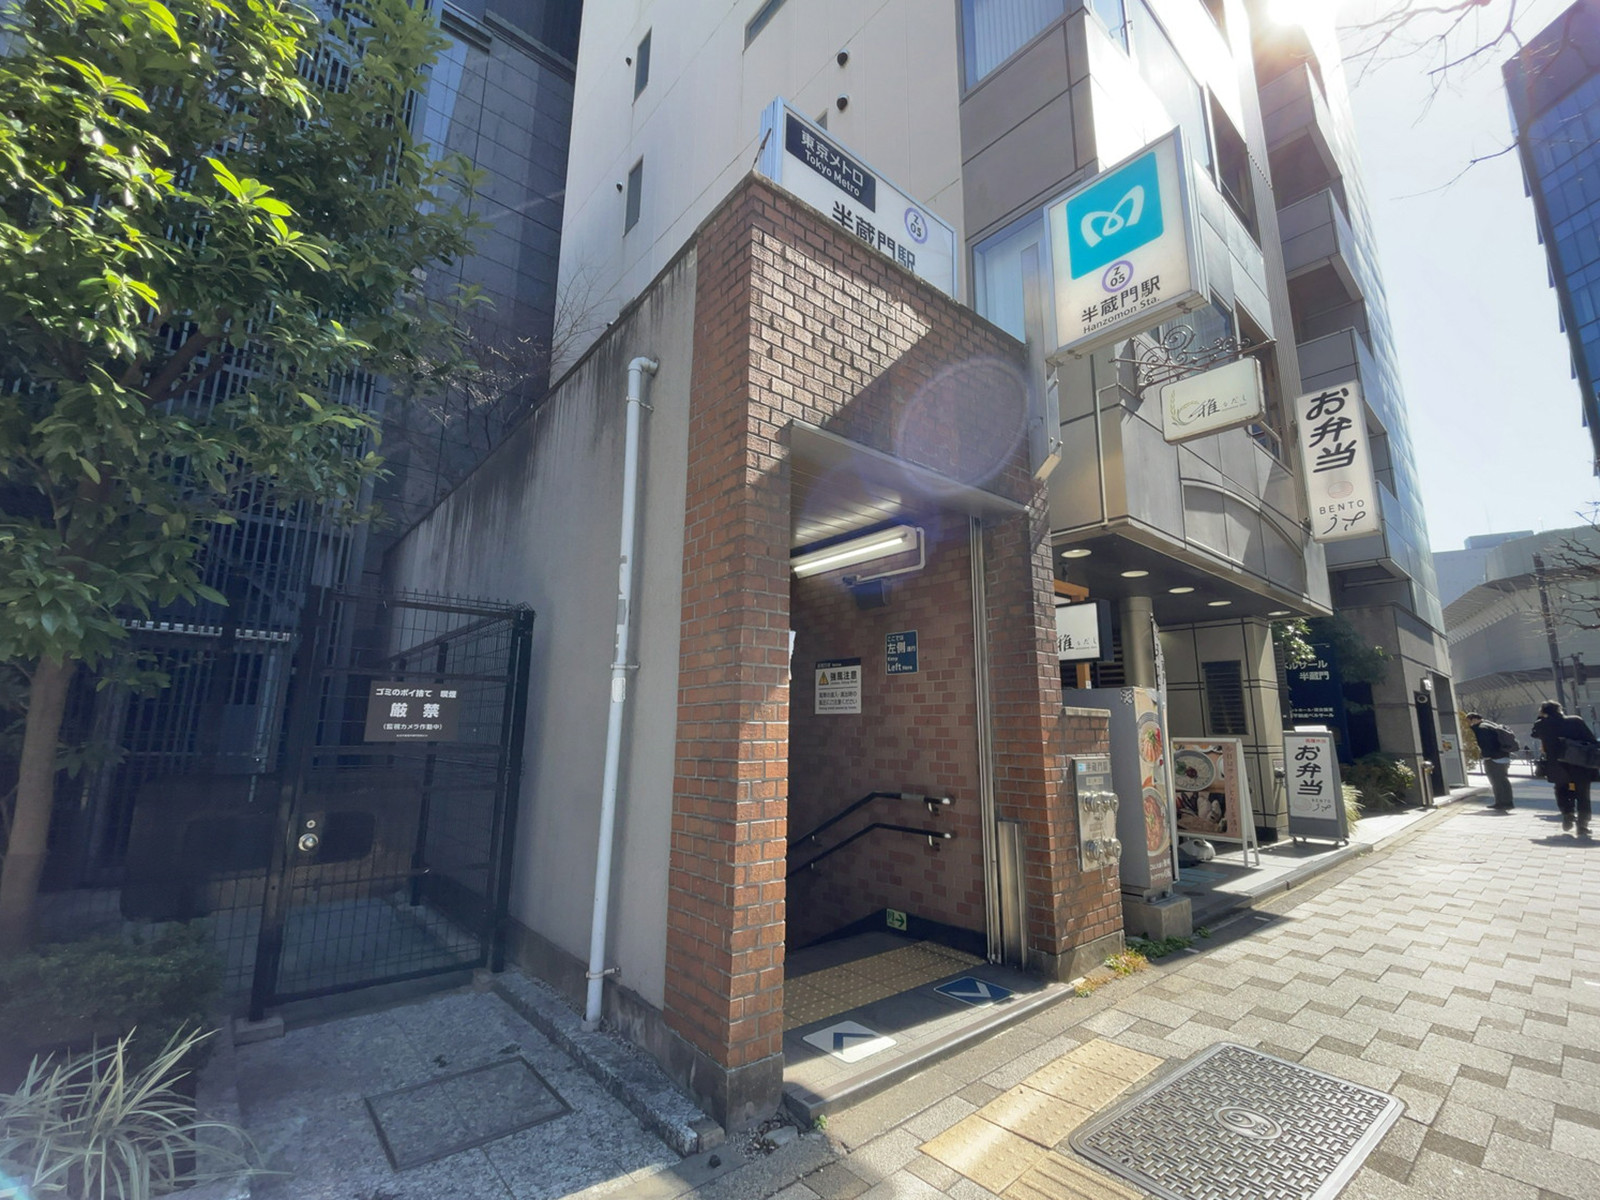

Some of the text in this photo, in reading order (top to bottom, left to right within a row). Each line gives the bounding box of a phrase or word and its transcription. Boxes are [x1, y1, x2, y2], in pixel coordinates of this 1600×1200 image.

[801, 130, 863, 187] 東京メトロ
[804, 150, 860, 197] Tokyo Metro
[832, 201, 916, 272] 半蔵門駅
[910, 223, 922, 238] 05
[1110, 274, 1125, 287] 05
[1114, 266, 1121, 276] Z
[1081, 275, 1161, 323] 半蔵門駅
[1083, 297, 1160, 335] Hanzomon Sta.
[1306, 387, 1357, 473] お弁当
[1319, 499, 1365, 515] BENTO
[887, 662, 901, 672] Left
[1295, 745, 1323, 796] お弁当
